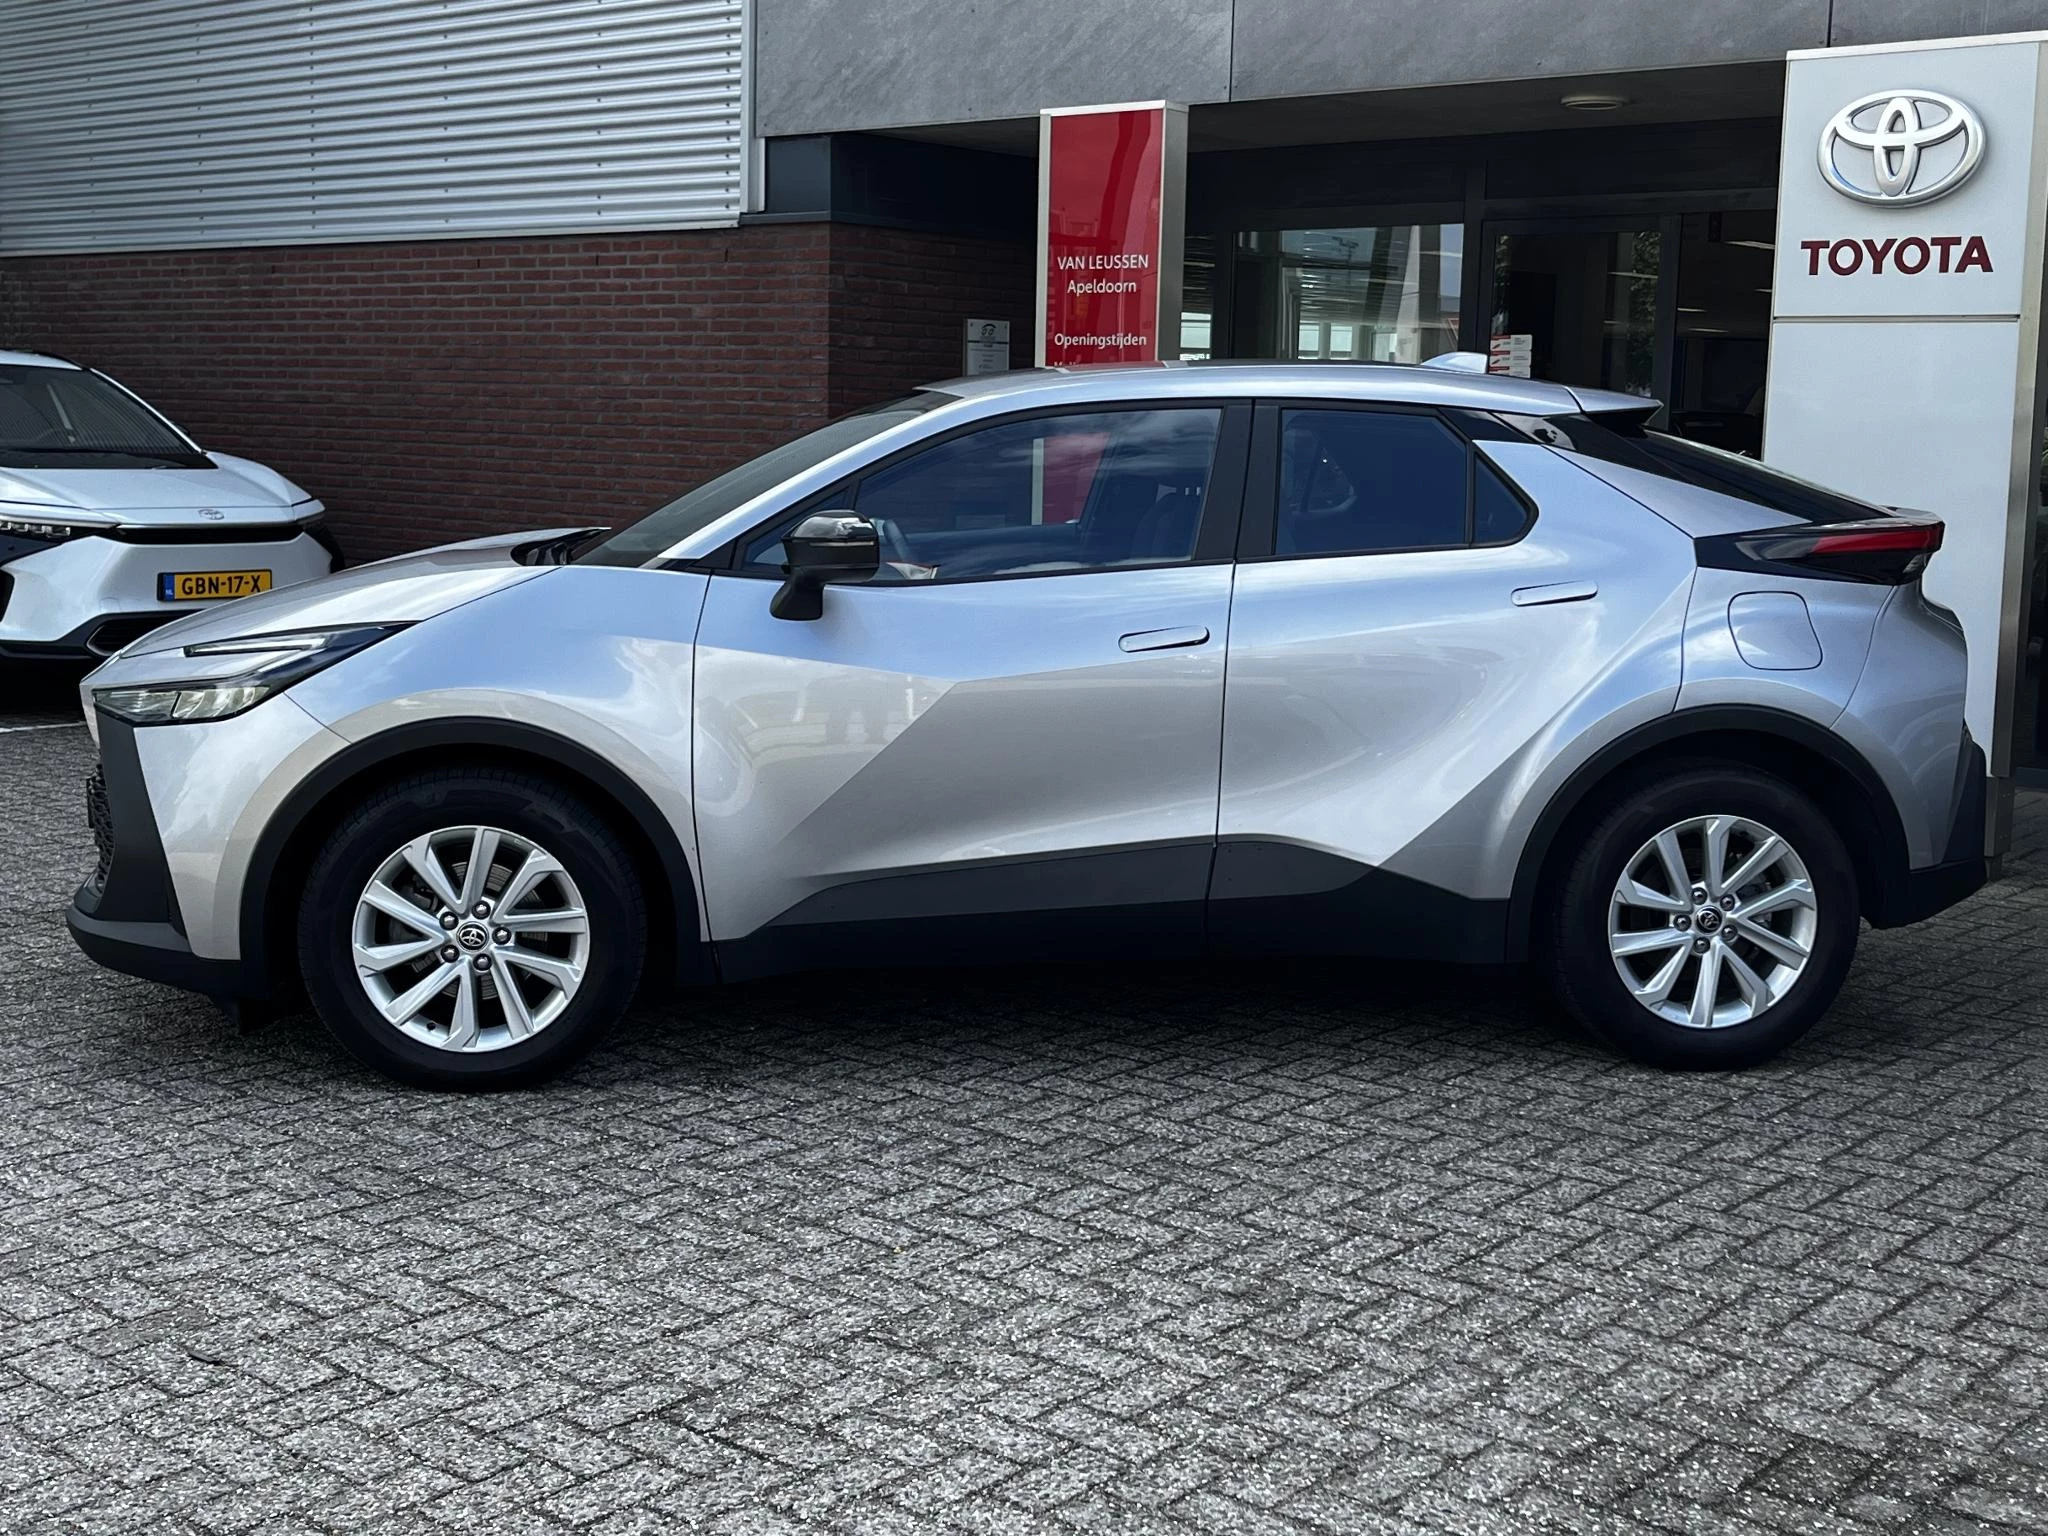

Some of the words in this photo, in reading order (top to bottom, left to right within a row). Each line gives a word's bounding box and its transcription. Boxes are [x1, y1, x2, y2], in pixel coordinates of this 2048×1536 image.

[1057, 255, 1085, 270] VAN
[1089, 254, 1149, 270] LEUSSEN
[1800, 236, 1994, 276] TOYOTA
[1067, 279, 1137, 296] Apeldoorn
[1054, 333, 1147, 349] Openingstijden
[181, 575, 261, 595] GBN-17-X
